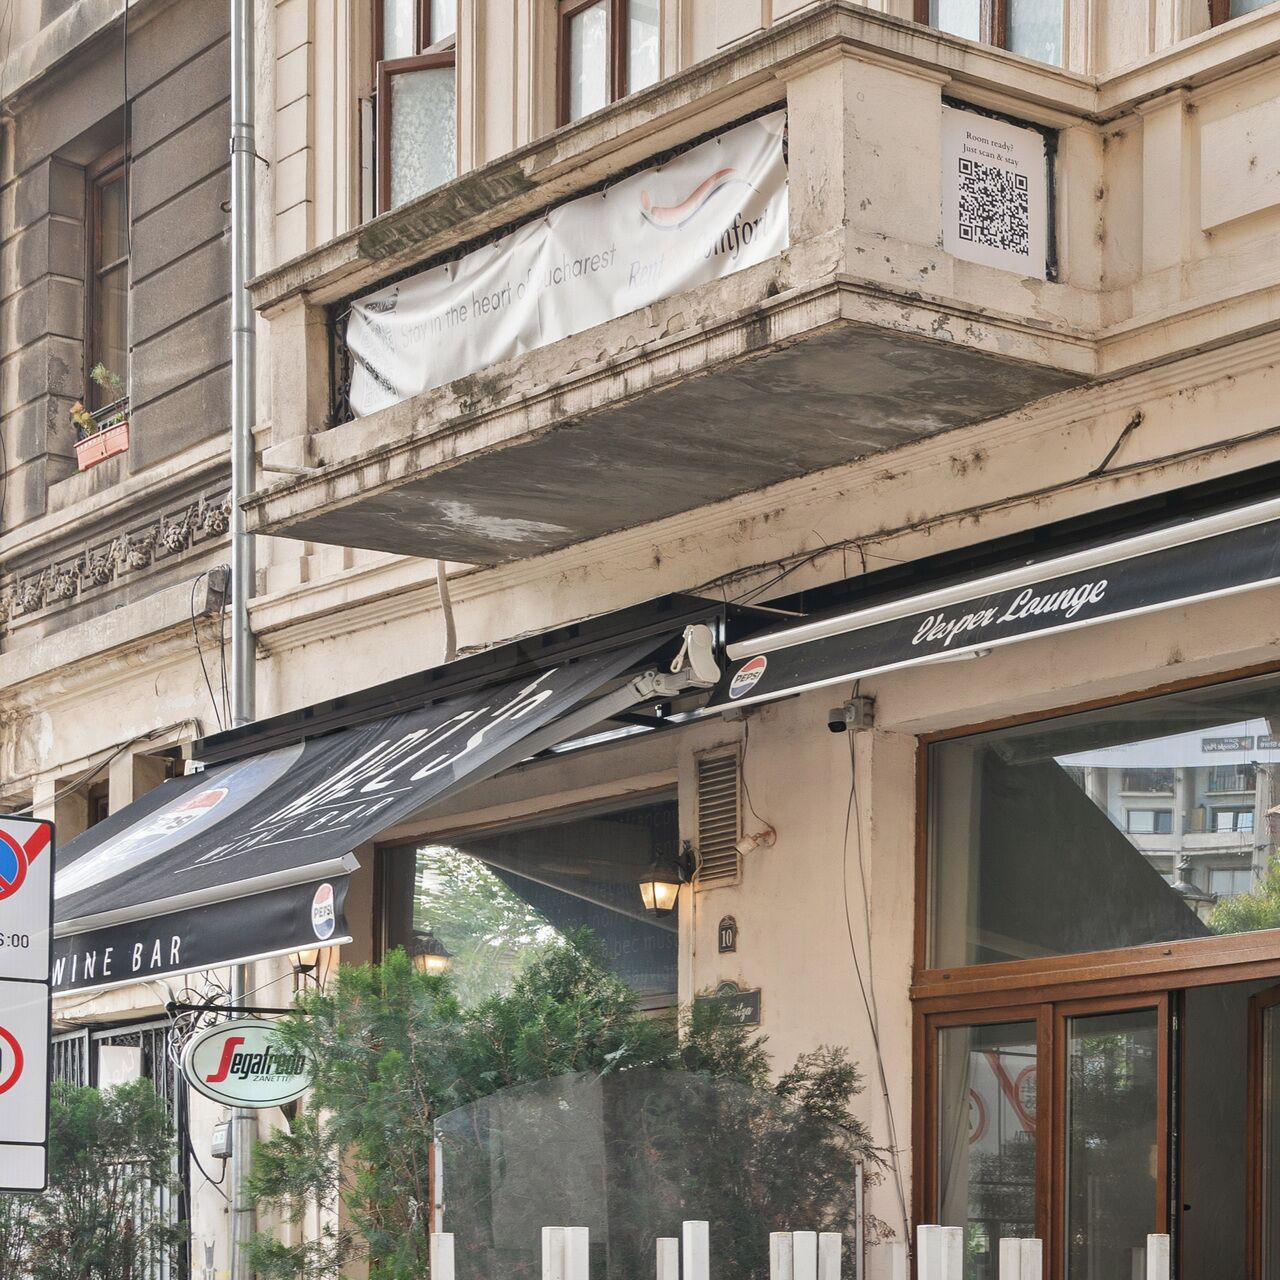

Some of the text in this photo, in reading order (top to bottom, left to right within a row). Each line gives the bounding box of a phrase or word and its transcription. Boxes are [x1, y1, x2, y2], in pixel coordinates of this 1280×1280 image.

[966, 131, 1014, 152] Room ready?
[962, 143, 977, 153] Just
[979, 149, 995, 159] scan
[1005, 156, 1019, 168] stay
[446, 304, 469, 330] the
[472, 281, 513, 318] heart
[544, 243, 617, 289] ucharest
[911, 579, 1109, 646] Vesper Lounge
[734, 671, 762, 684] PEPSI
[302, 795, 396, 832] BAR
[313, 904, 333, 920] PEPSI
[721, 929, 733, 947] 10
[52, 935, 181, 987] WINE BAR
